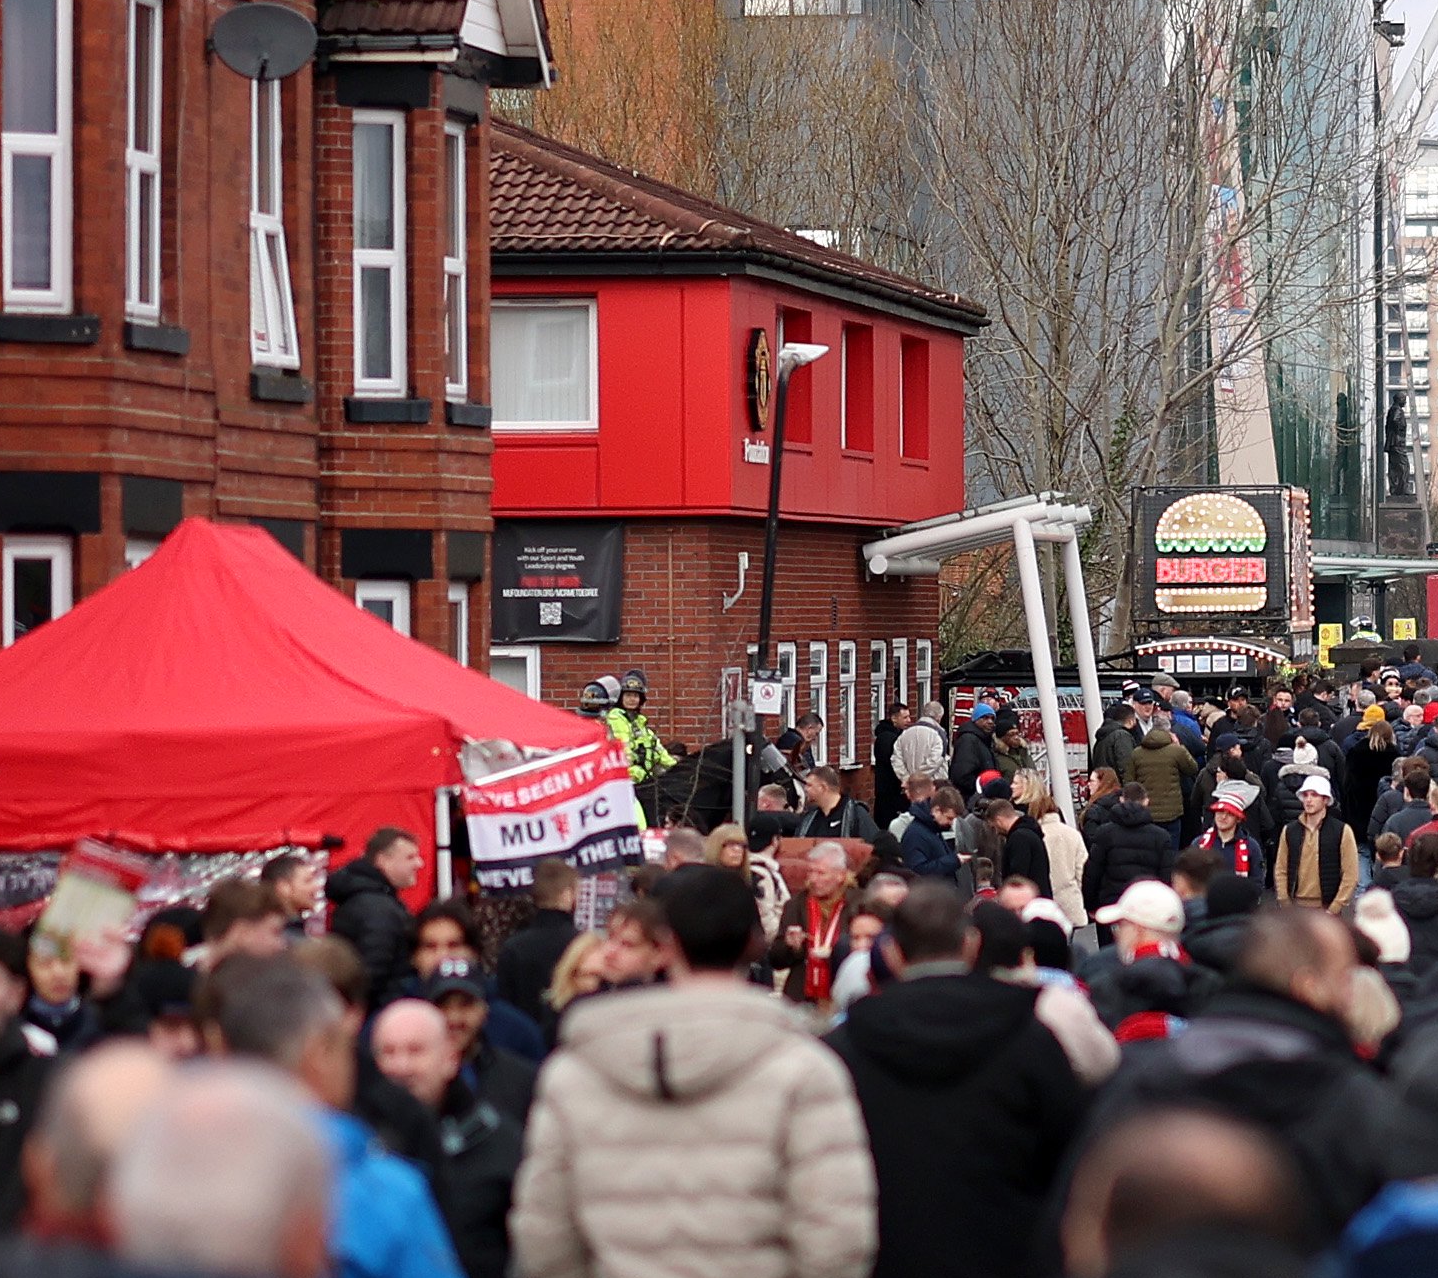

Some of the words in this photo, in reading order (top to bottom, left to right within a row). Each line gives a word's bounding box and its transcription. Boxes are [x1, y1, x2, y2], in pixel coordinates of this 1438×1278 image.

[1156, 557, 1263, 583] BURGER
[517, 772, 572, 805] SEEN
[574, 762, 595, 785] IT
[500, 820, 546, 847] MU
[580, 796, 610, 828] FC
[476, 866, 535, 888] WE'VE
[577, 840, 617, 866] THE
